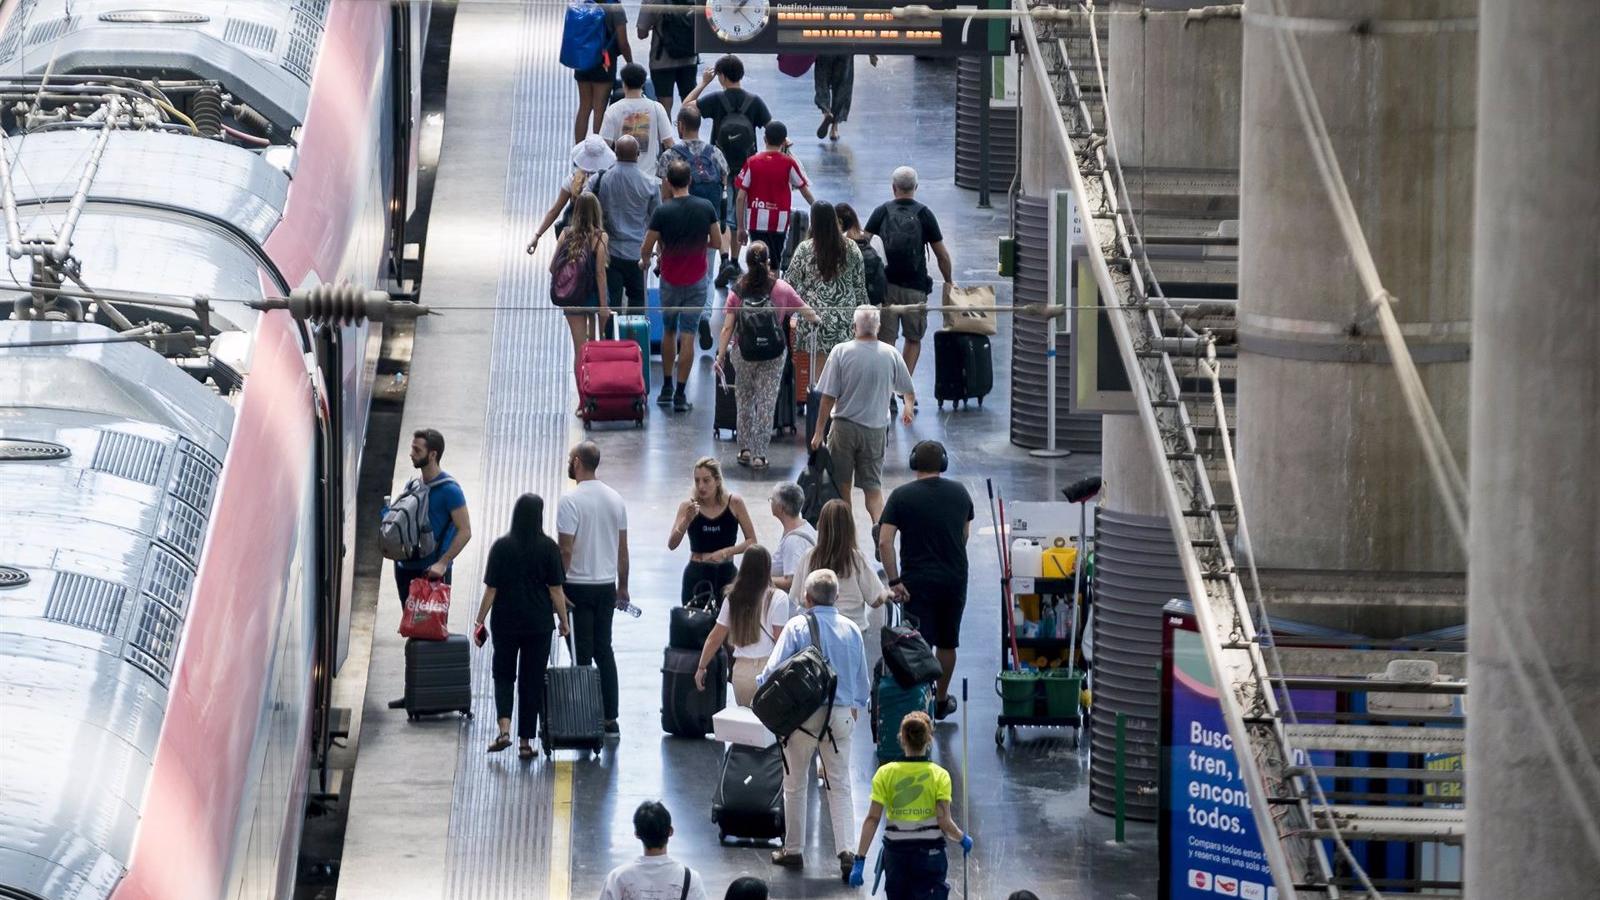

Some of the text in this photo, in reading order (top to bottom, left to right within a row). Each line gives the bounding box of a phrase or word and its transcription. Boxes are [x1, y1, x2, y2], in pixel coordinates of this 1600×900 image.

[752, 197, 765, 209] ria
[1190, 720, 1233, 750] Busc
[1189, 750, 1232, 782] tren,
[1188, 780, 1252, 809] encont
[1188, 803, 1246, 835] todos.
[1188, 836, 1221, 851] Compara
[1222, 843, 1241, 855] todos
[1243, 848, 1261, 860] estos
[1188, 848, 1193, 858] y
[1194, 850, 1220, 862] reserva
[1221, 856, 1230, 864] en
[1231, 858, 1245, 868] una
[1245, 861, 1260, 871] sola
